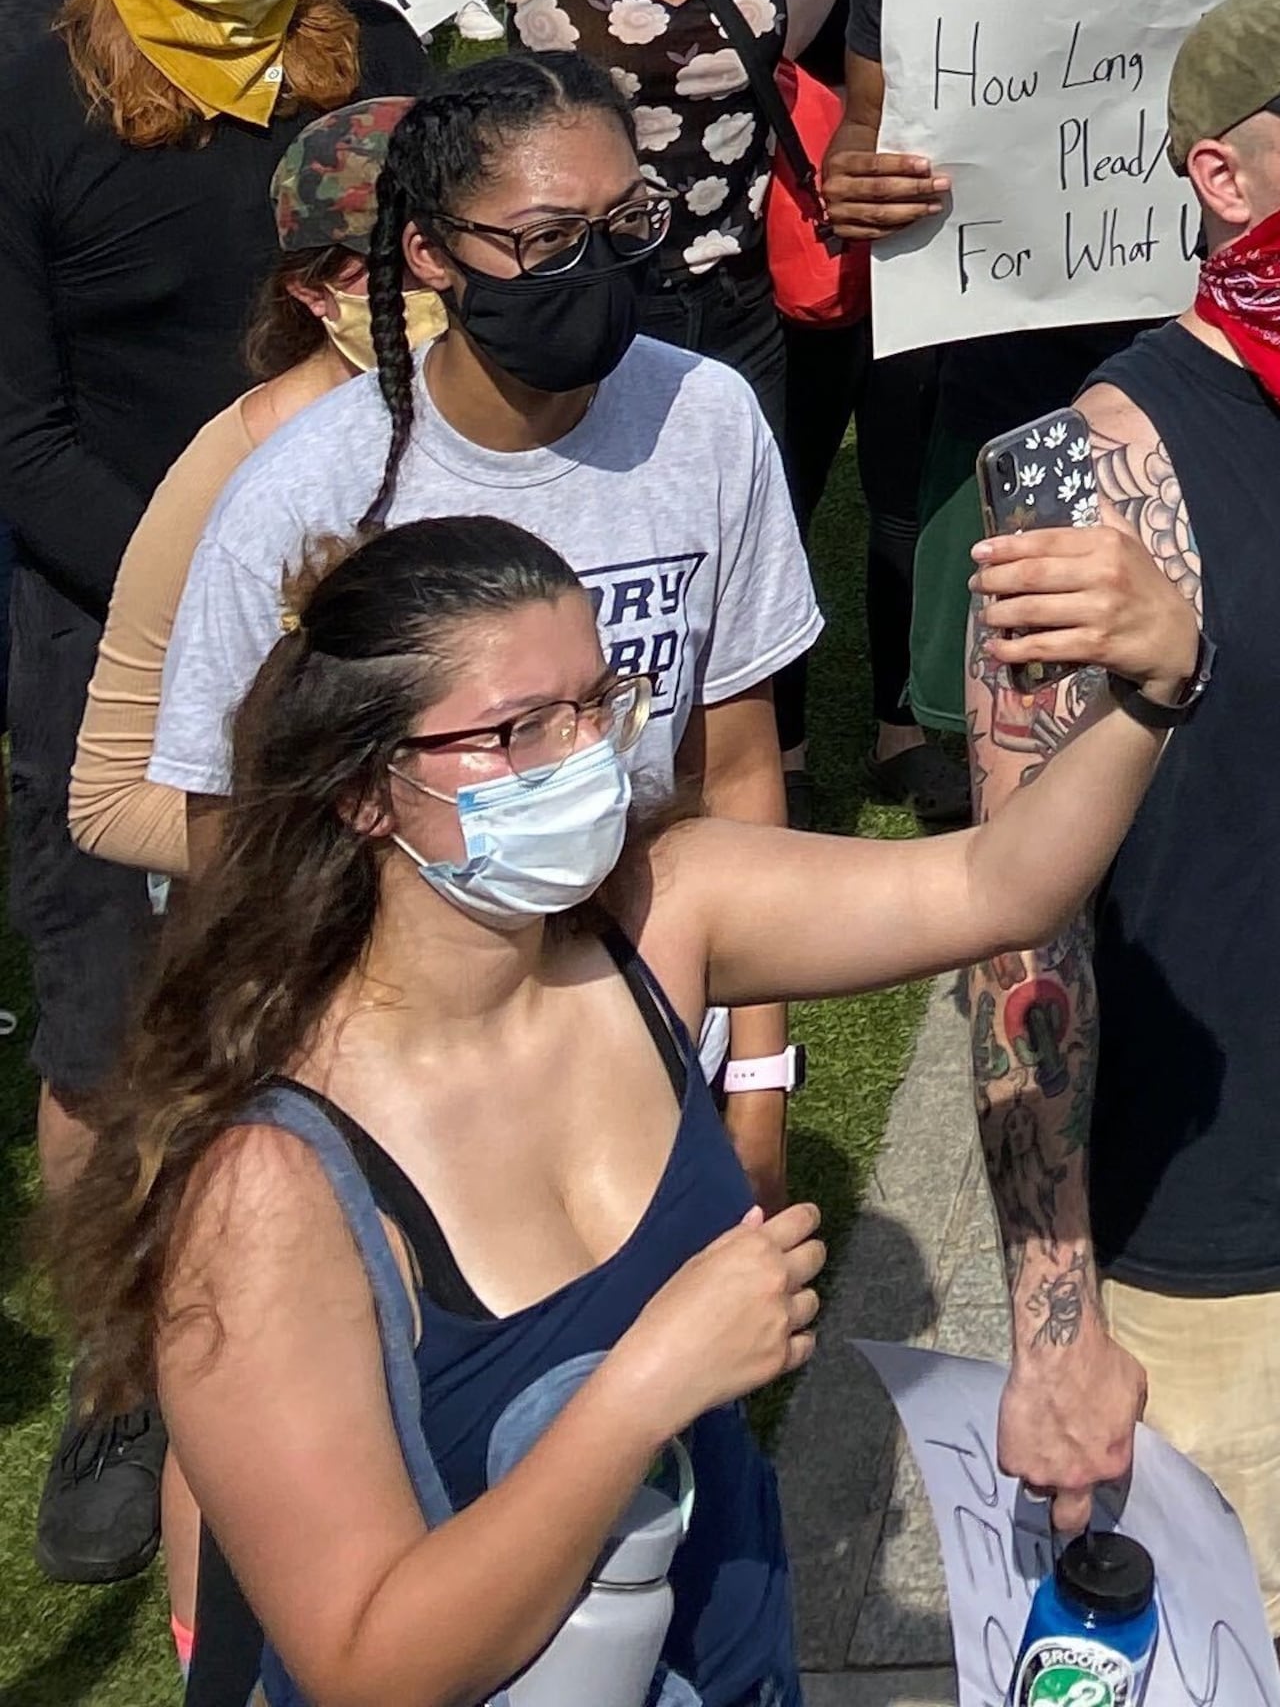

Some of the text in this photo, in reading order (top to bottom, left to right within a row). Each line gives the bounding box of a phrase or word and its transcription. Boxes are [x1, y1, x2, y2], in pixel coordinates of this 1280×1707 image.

[934, 17, 1145, 109] How Long
[956, 219, 1032, 294] For
[1066, 205, 1160, 281] What
